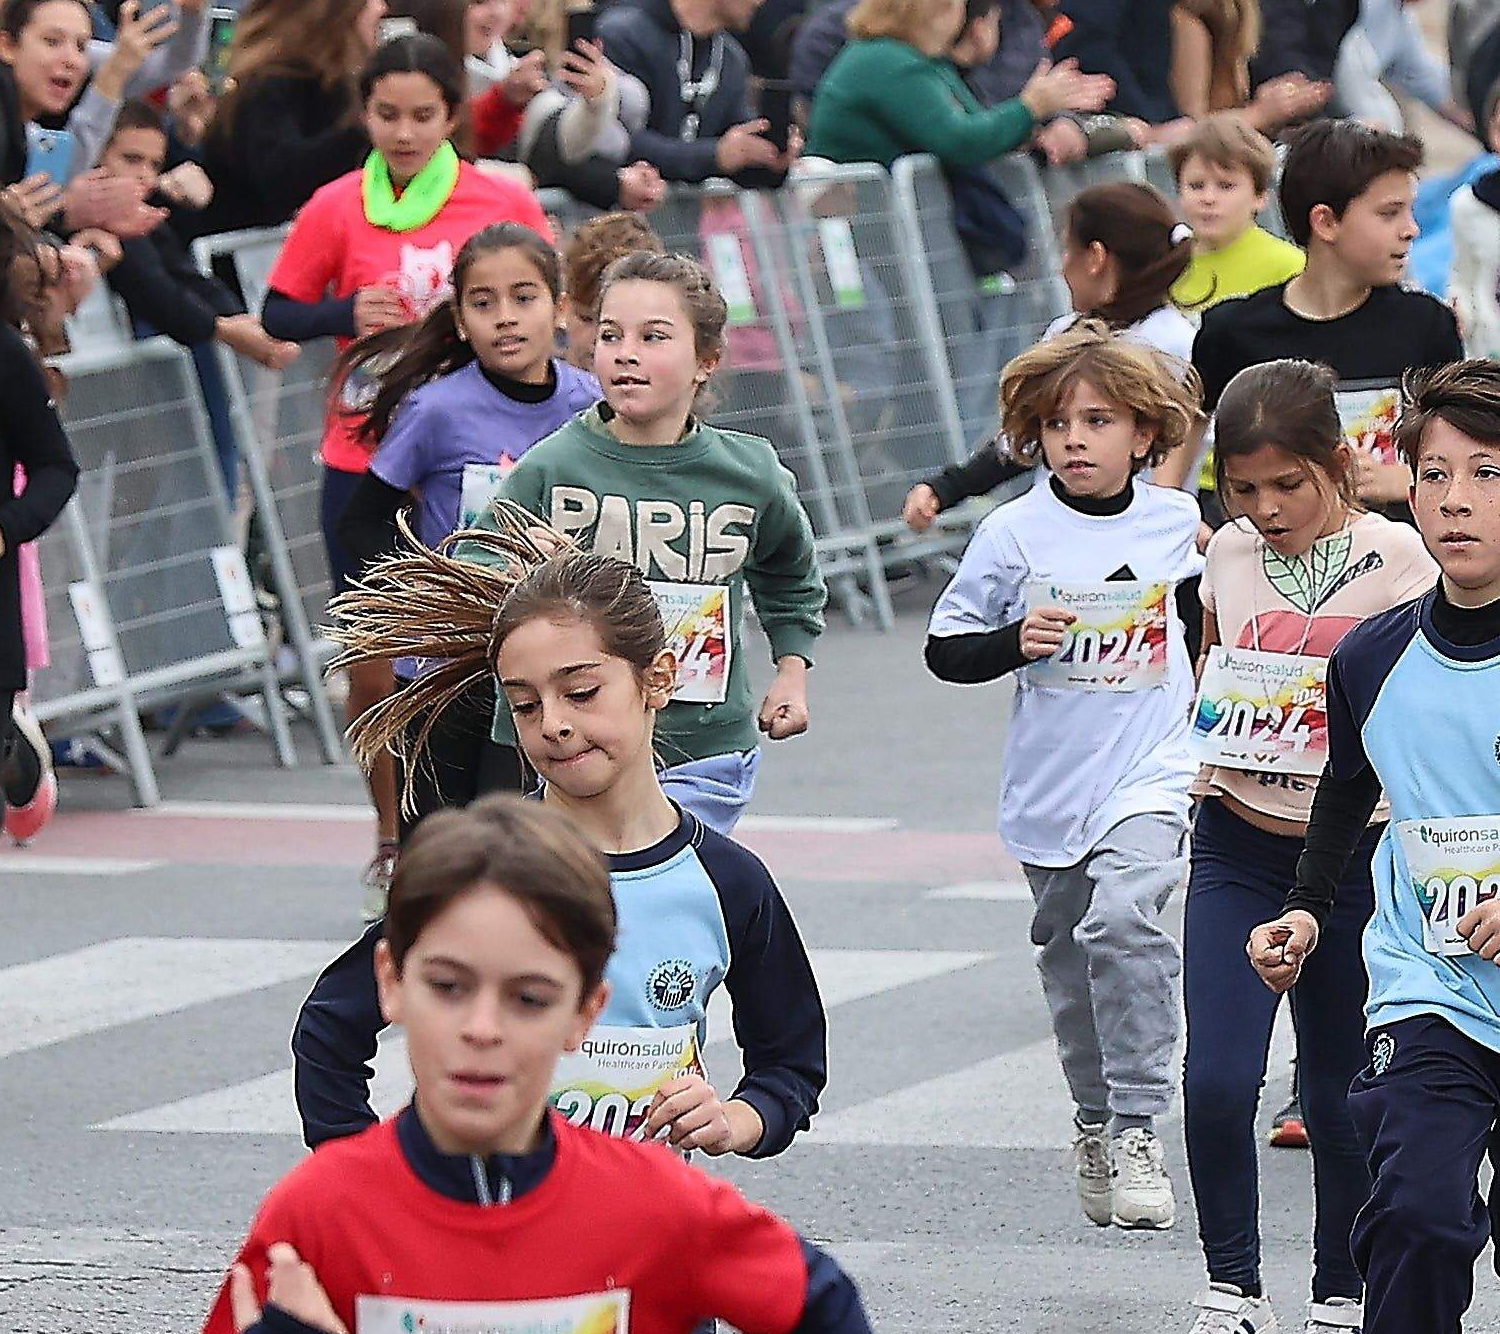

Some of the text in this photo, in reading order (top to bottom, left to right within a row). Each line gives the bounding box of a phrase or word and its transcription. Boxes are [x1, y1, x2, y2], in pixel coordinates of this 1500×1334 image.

[1207, 697, 1311, 754] 2024
[1444, 844, 1491, 855] Healthcare
[581, 1039, 684, 1058] quirónsalud
